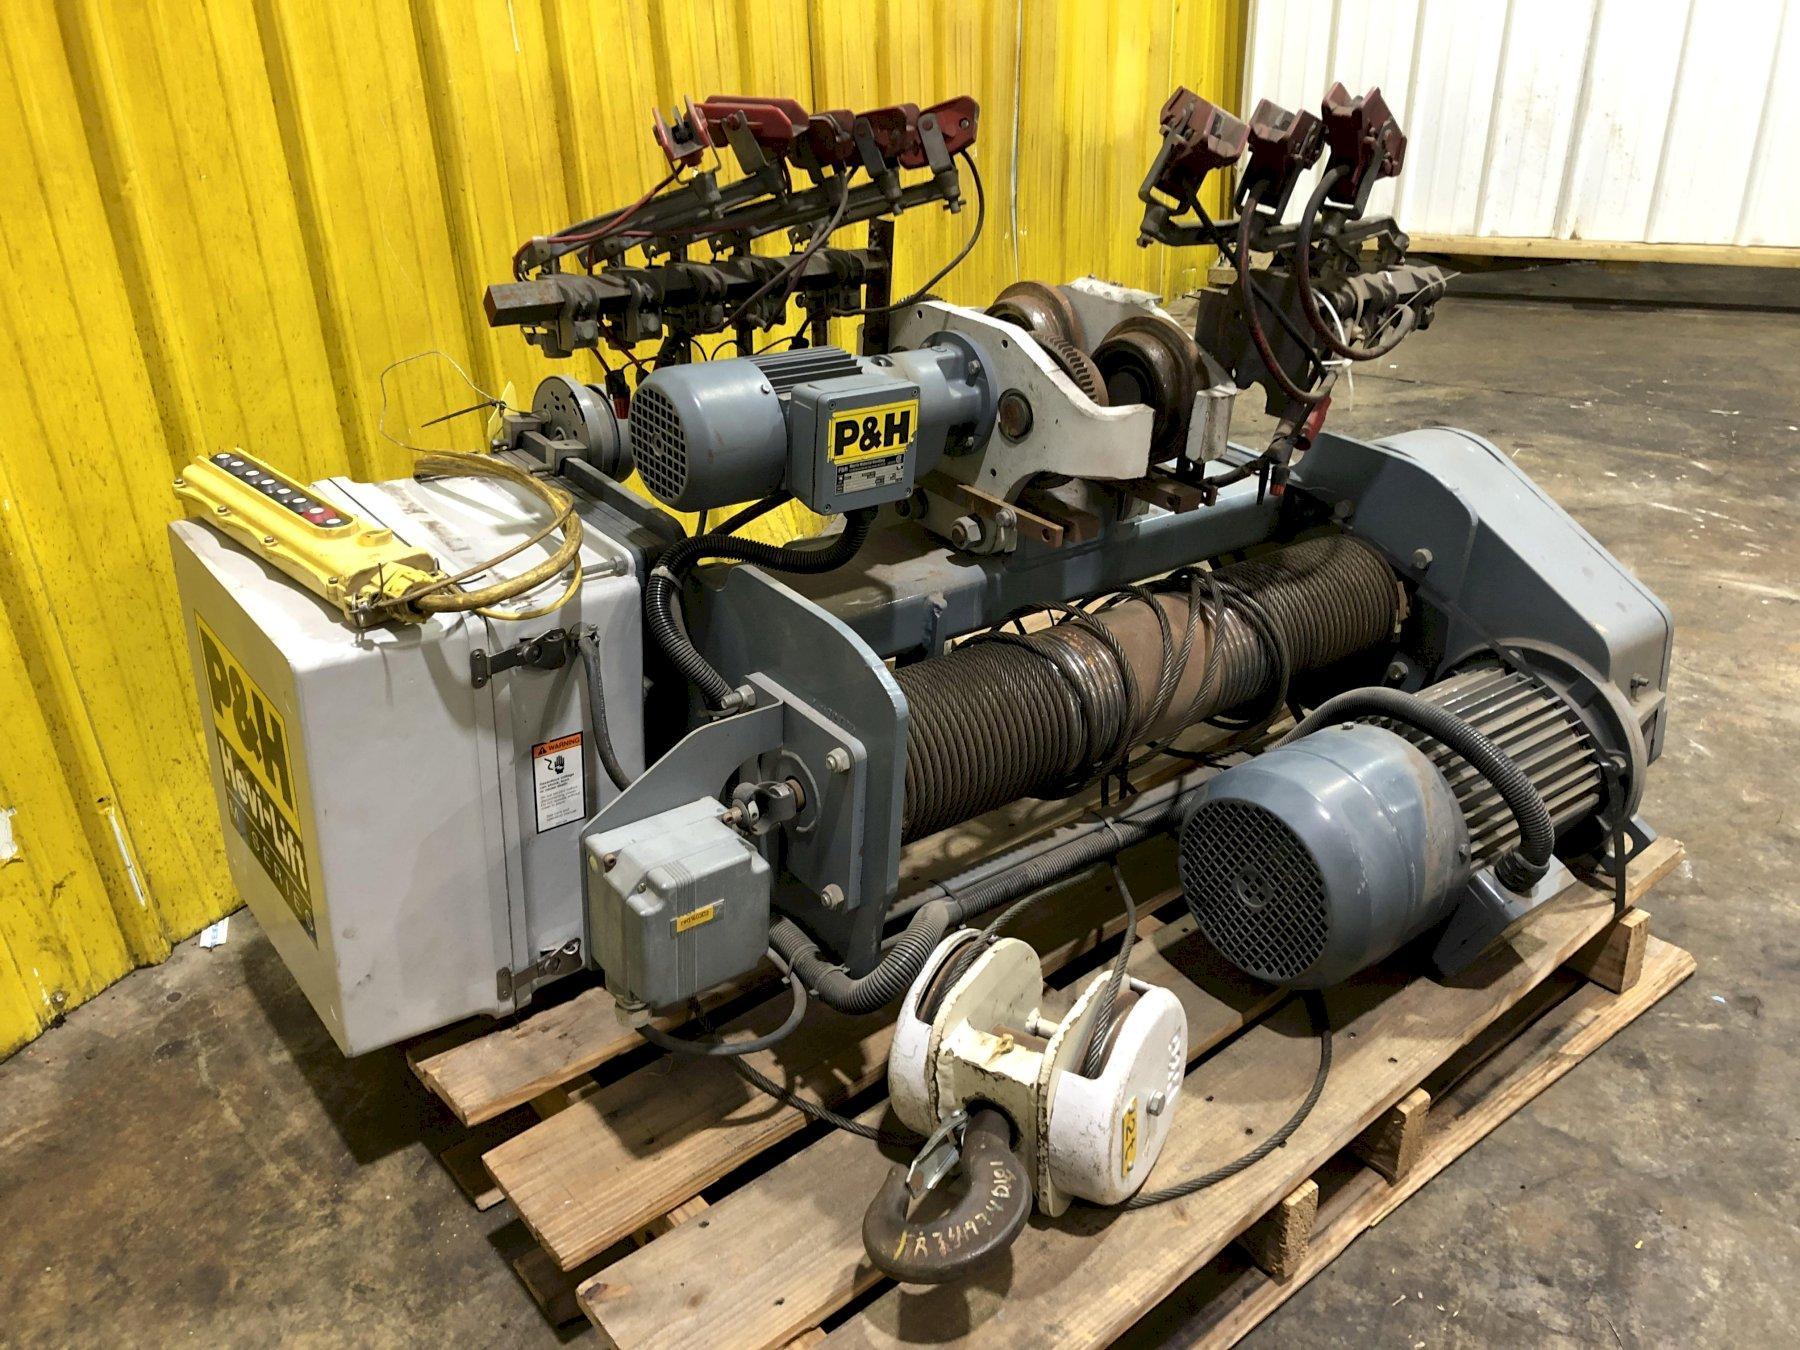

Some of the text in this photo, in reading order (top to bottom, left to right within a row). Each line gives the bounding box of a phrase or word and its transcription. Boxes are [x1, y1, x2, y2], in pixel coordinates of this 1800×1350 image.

[835, 410, 910, 456] P&H
[201, 632, 293, 811] P&H
[548, 737, 580, 751] WARNING
[219, 737, 308, 889] Hevi-Lift
[252, 830, 315, 933] SERIES
